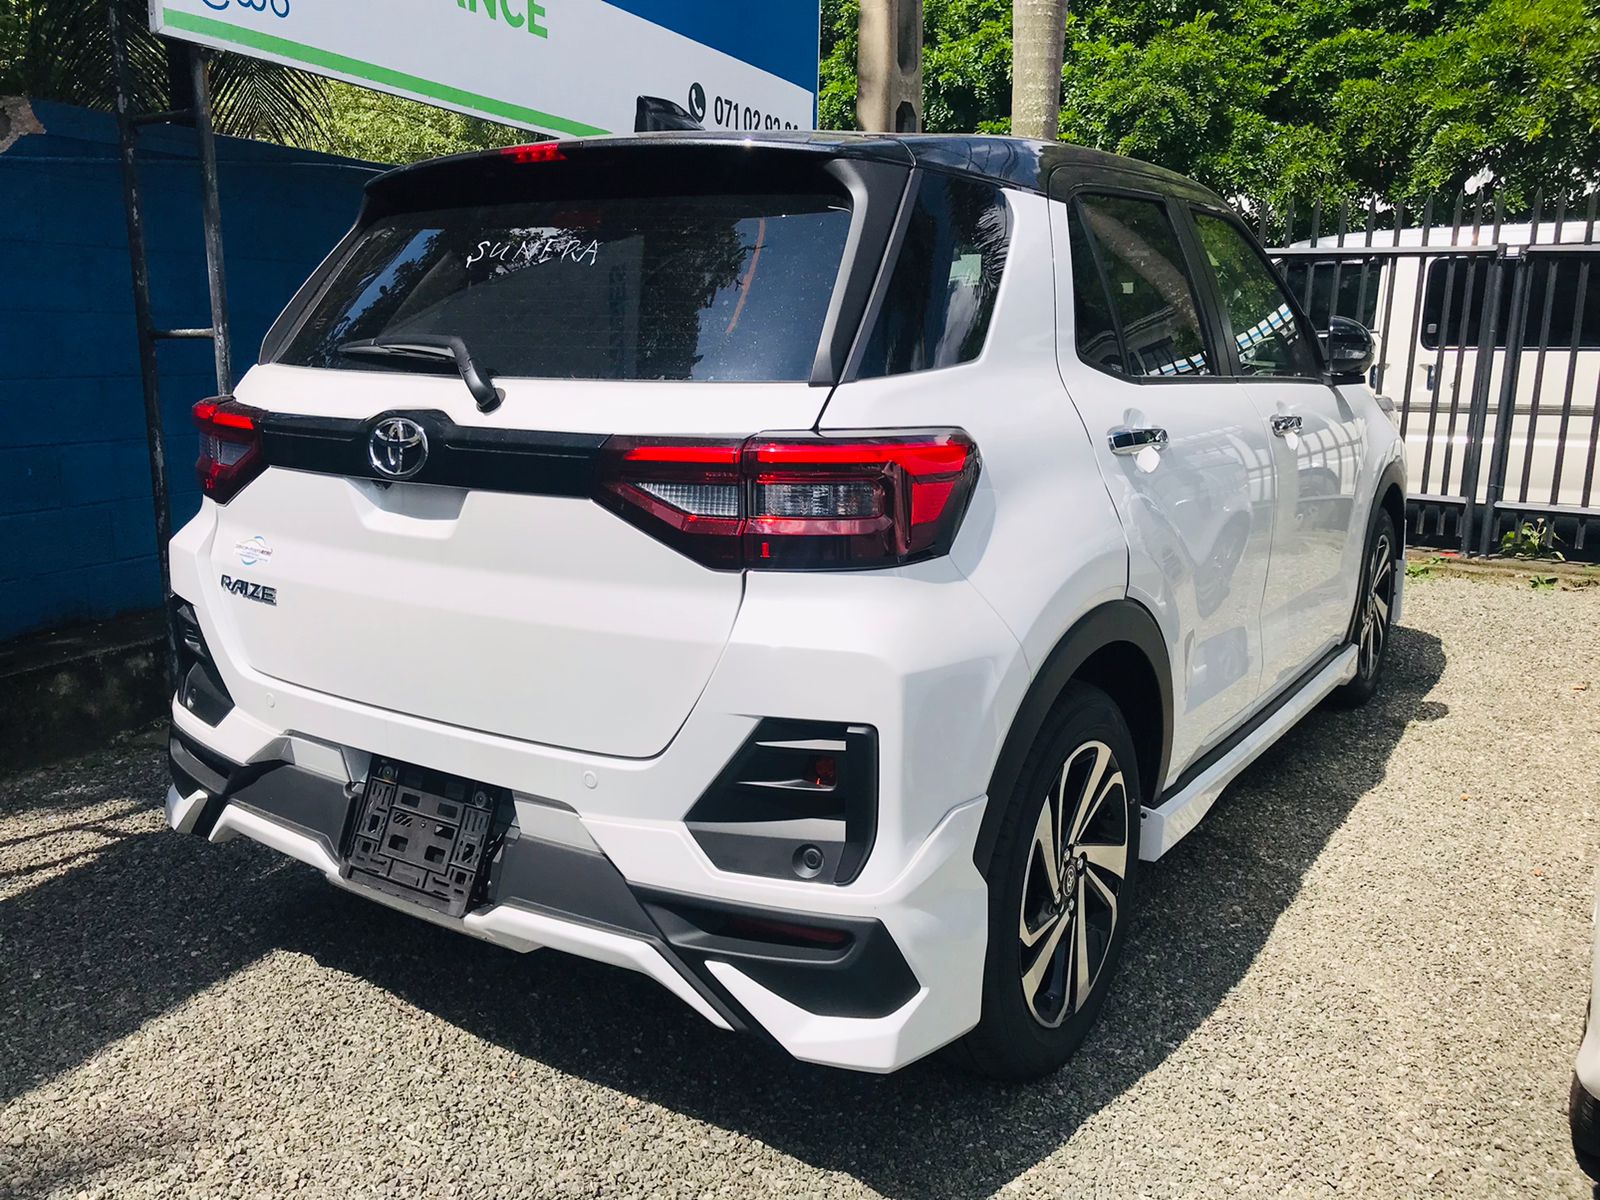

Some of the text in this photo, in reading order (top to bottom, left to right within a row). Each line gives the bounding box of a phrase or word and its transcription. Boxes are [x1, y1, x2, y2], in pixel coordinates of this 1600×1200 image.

[457, 0, 548, 39] CE
[714, 96, 739, 130] 071
[743, 107, 761, 130] 02
[220, 574, 277, 606] RAIZE
